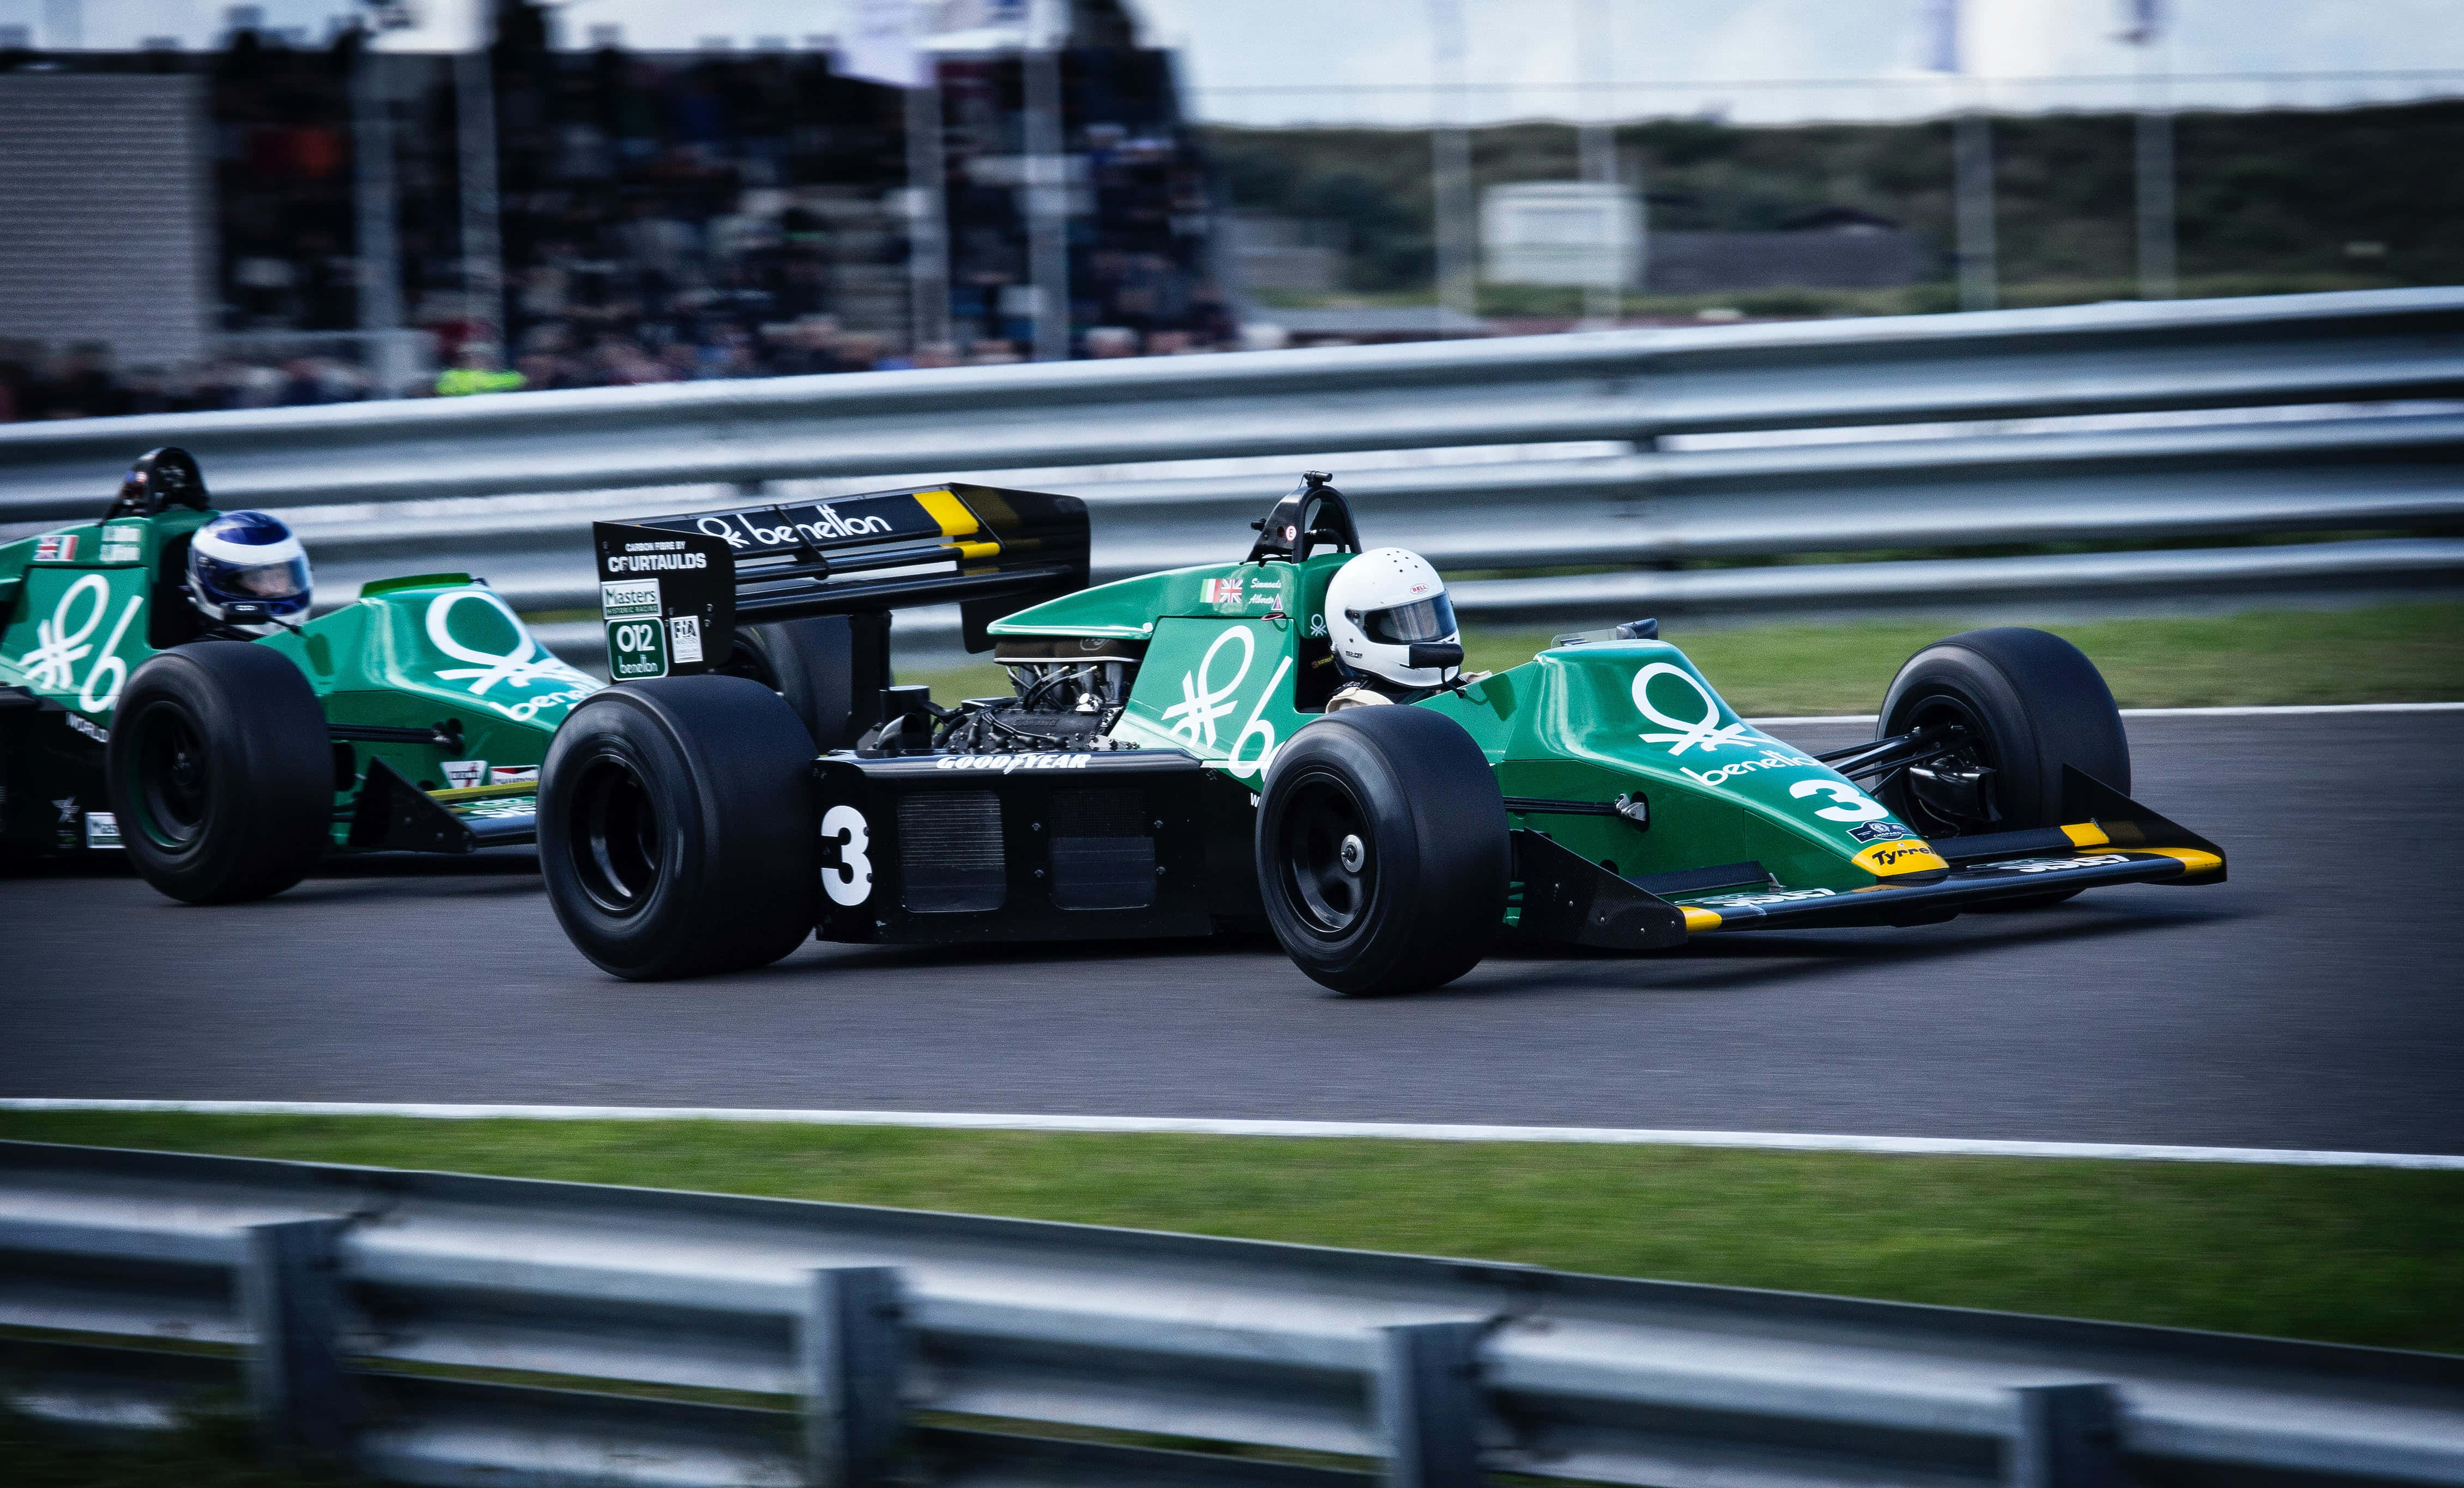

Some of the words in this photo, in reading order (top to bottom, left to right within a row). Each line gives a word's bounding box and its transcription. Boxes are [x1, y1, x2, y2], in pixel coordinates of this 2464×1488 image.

[736, 504, 893, 545] benetton
[605, 588, 656, 605] Masters
[617, 624, 655, 652] 012
[618, 654, 659, 673] benetton
[936, 753, 1091, 774] GOODYEAR
[1679, 750, 1820, 786] benetto
[1789, 780, 1889, 821] 3
[821, 805, 872, 906] 3
